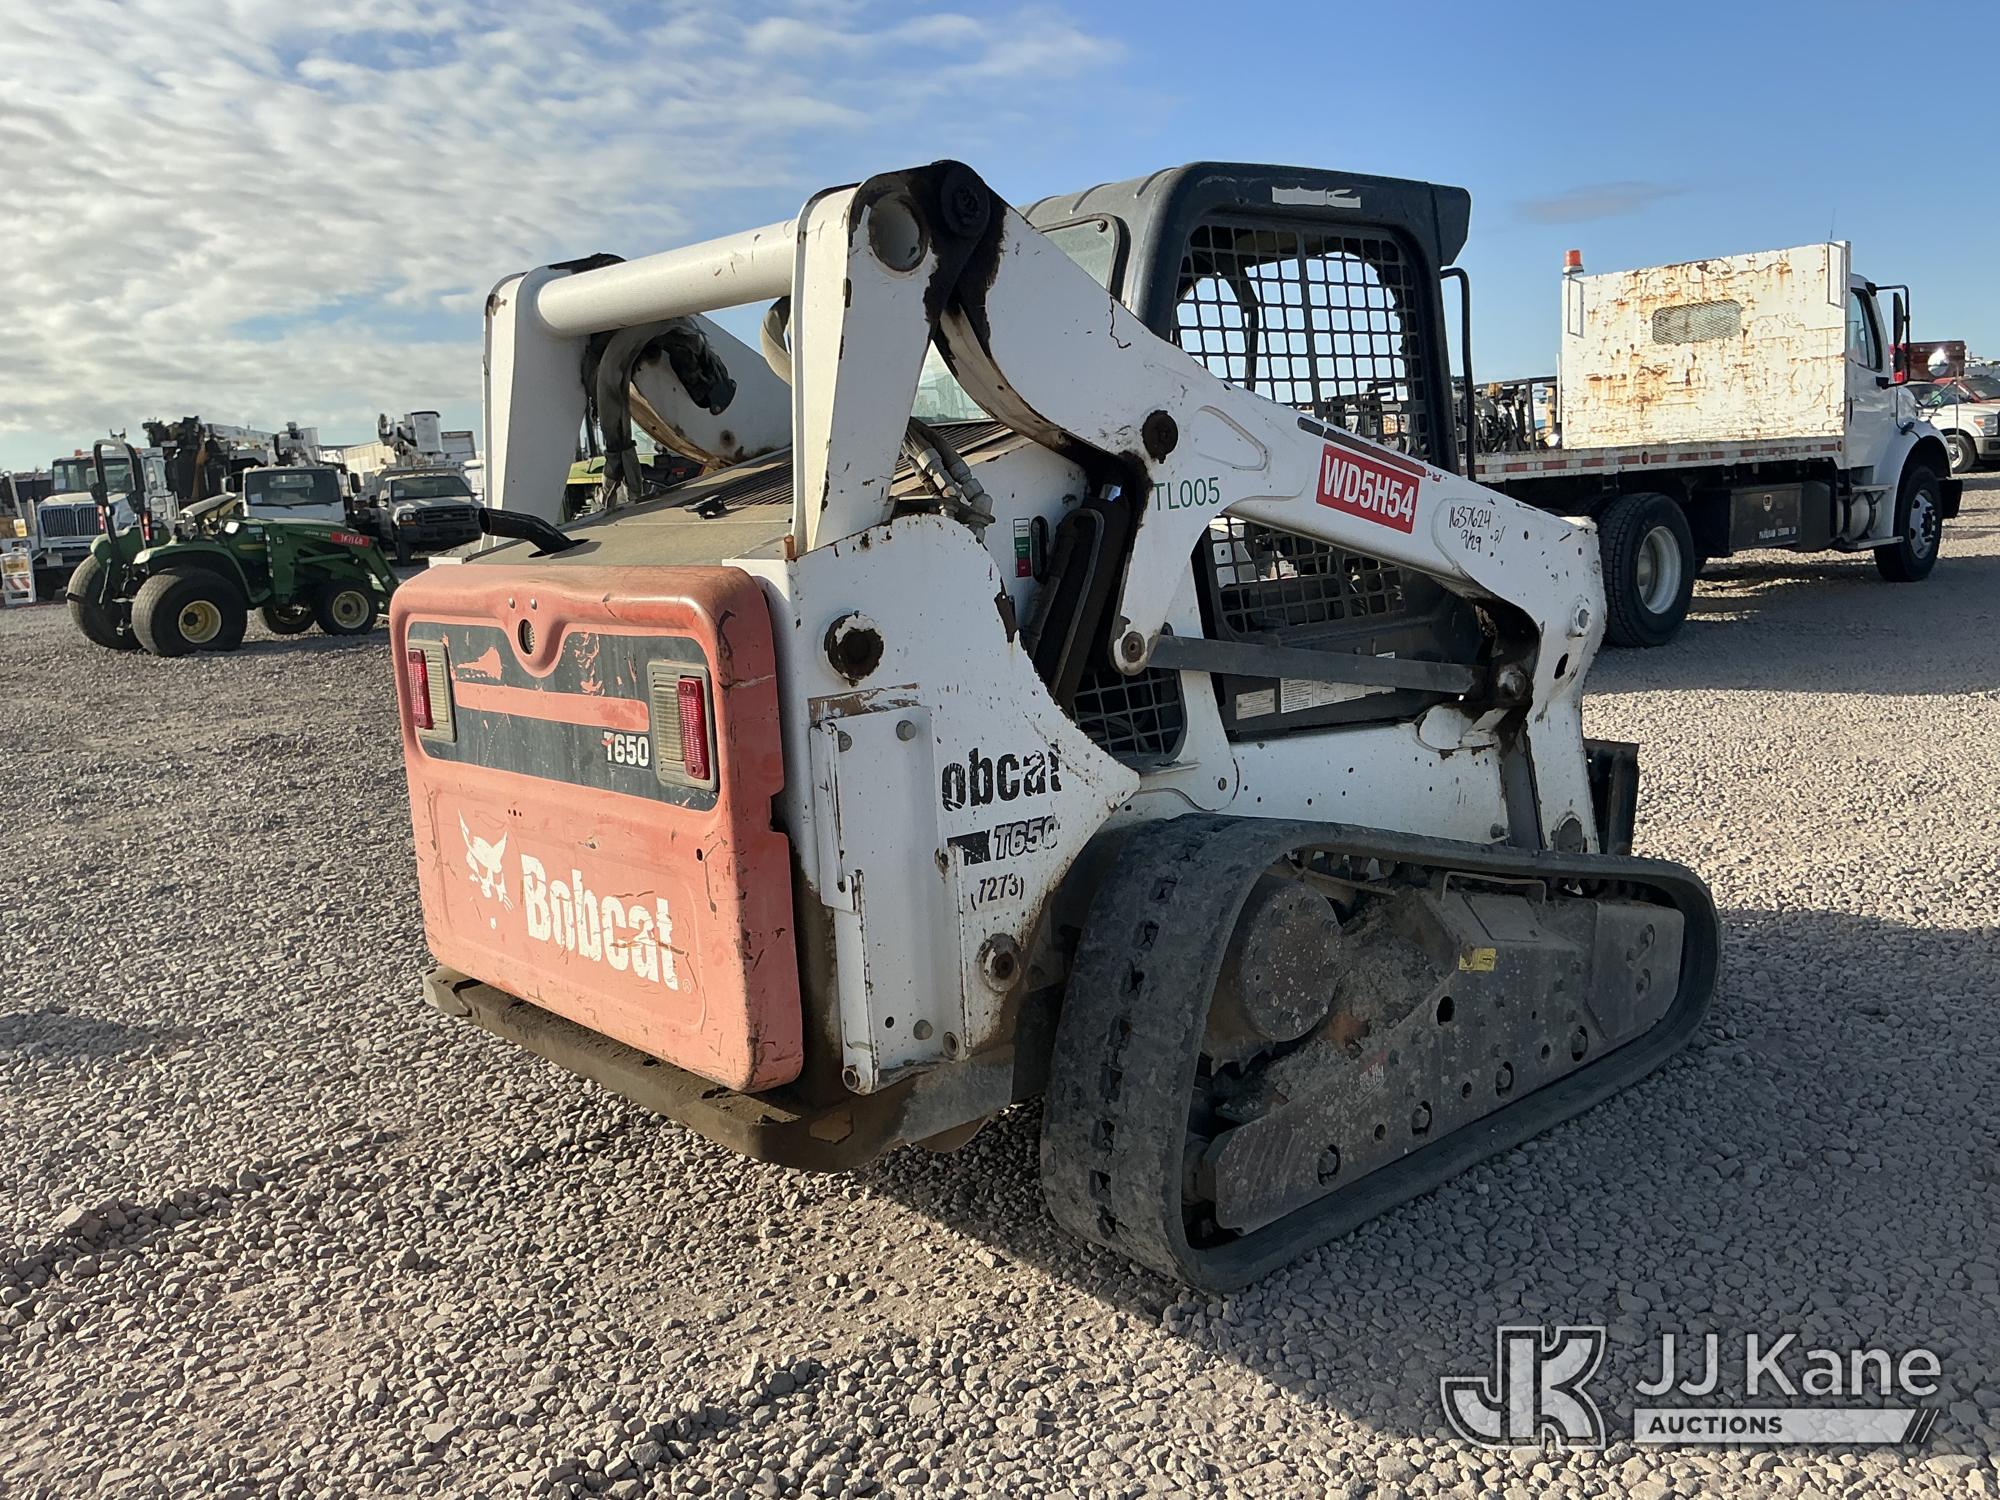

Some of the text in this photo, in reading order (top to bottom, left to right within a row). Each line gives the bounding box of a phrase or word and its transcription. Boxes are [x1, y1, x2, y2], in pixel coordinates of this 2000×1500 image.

[1153, 477, 1220, 511] TL005
[1323, 455, 1415, 523] WD5H54
[603, 731, 650, 767] T650
[971, 873, 1024, 911] (7273)
[520, 854, 679, 991] Bobcat
